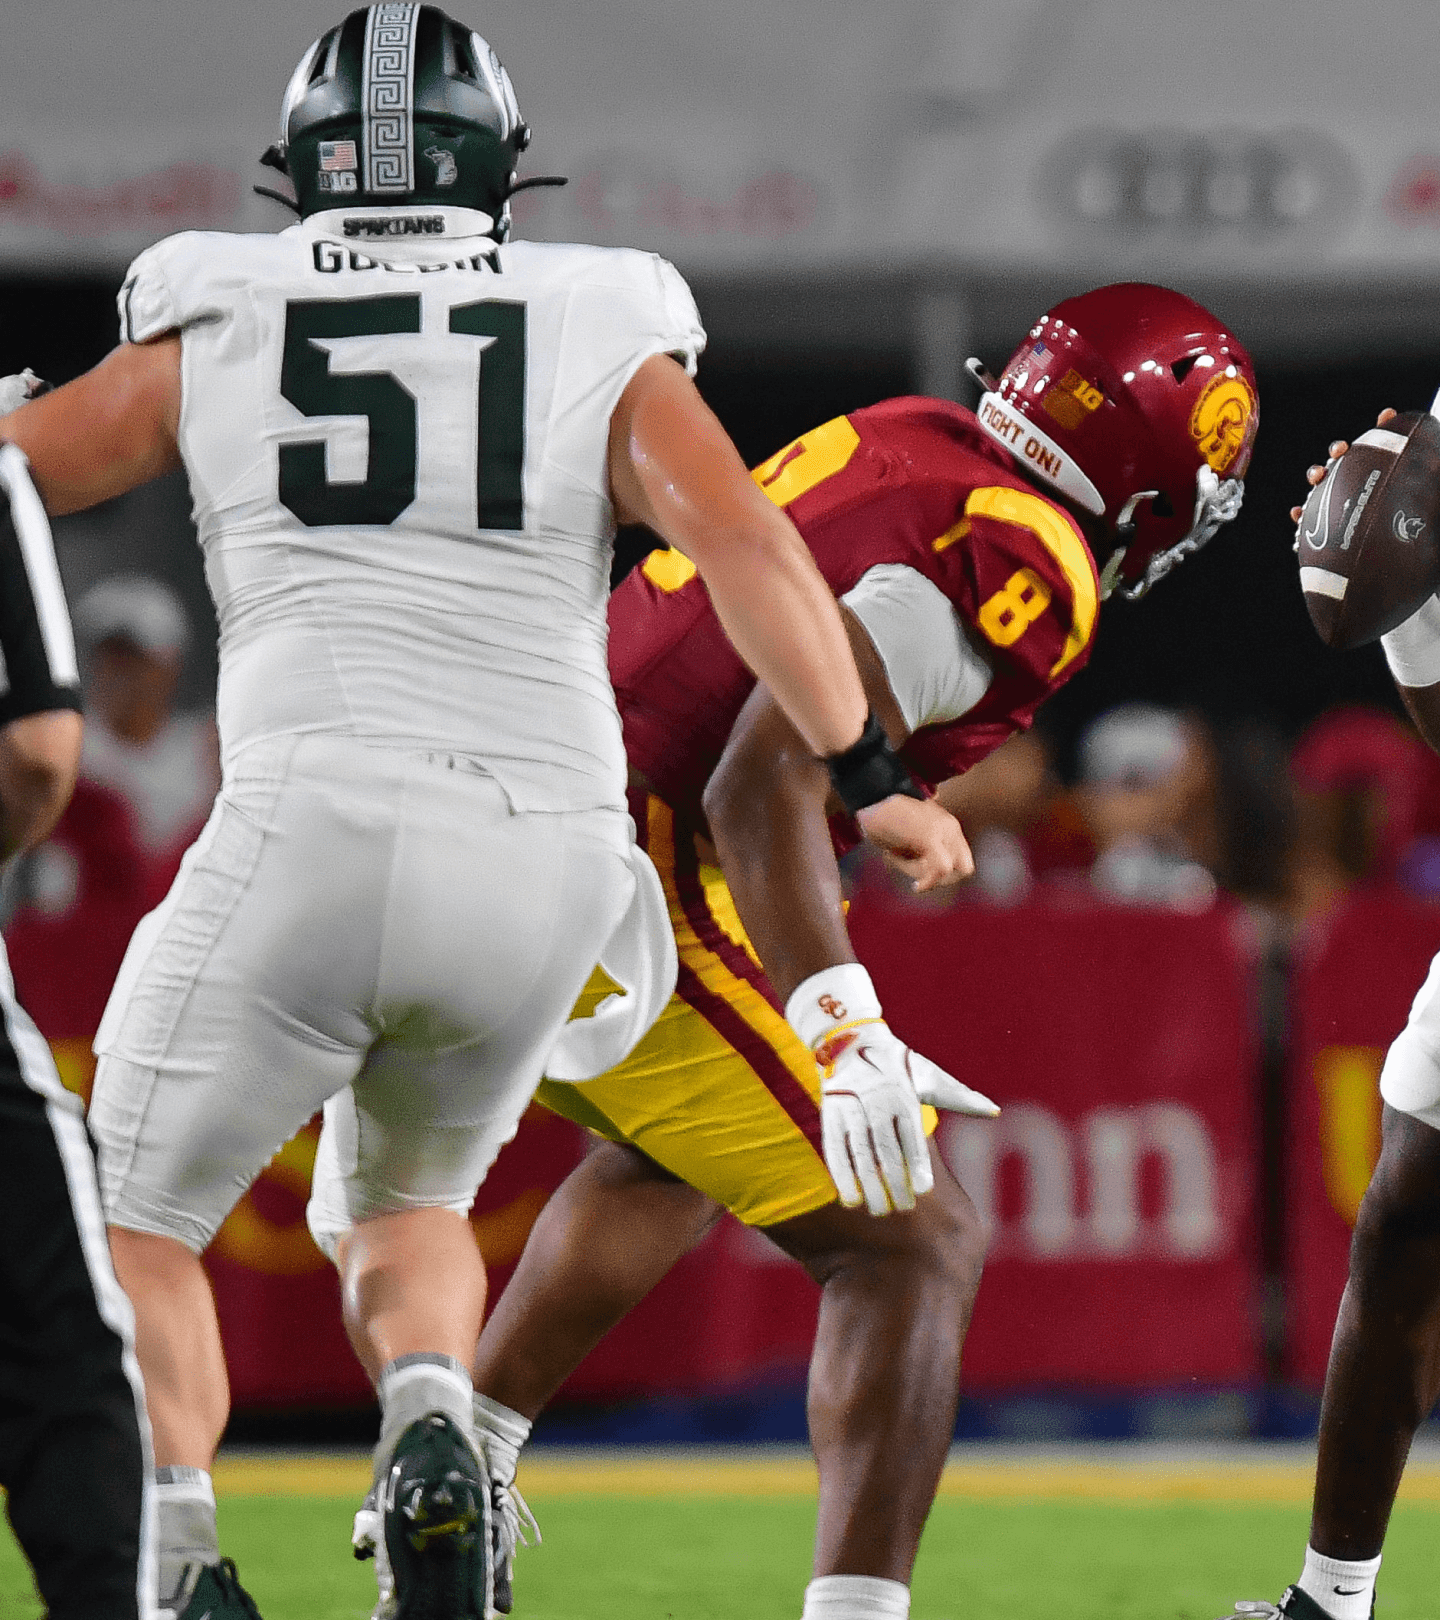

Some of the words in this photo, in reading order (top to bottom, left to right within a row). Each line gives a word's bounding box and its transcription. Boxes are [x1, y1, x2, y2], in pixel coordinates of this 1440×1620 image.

[343, 214, 446, 237] SPARTANS
[279, 293, 526, 530] 51
[981, 400, 1025, 444] FIGHT
[1024, 436, 1063, 478] ON!
[979, 568, 1051, 646] 8
